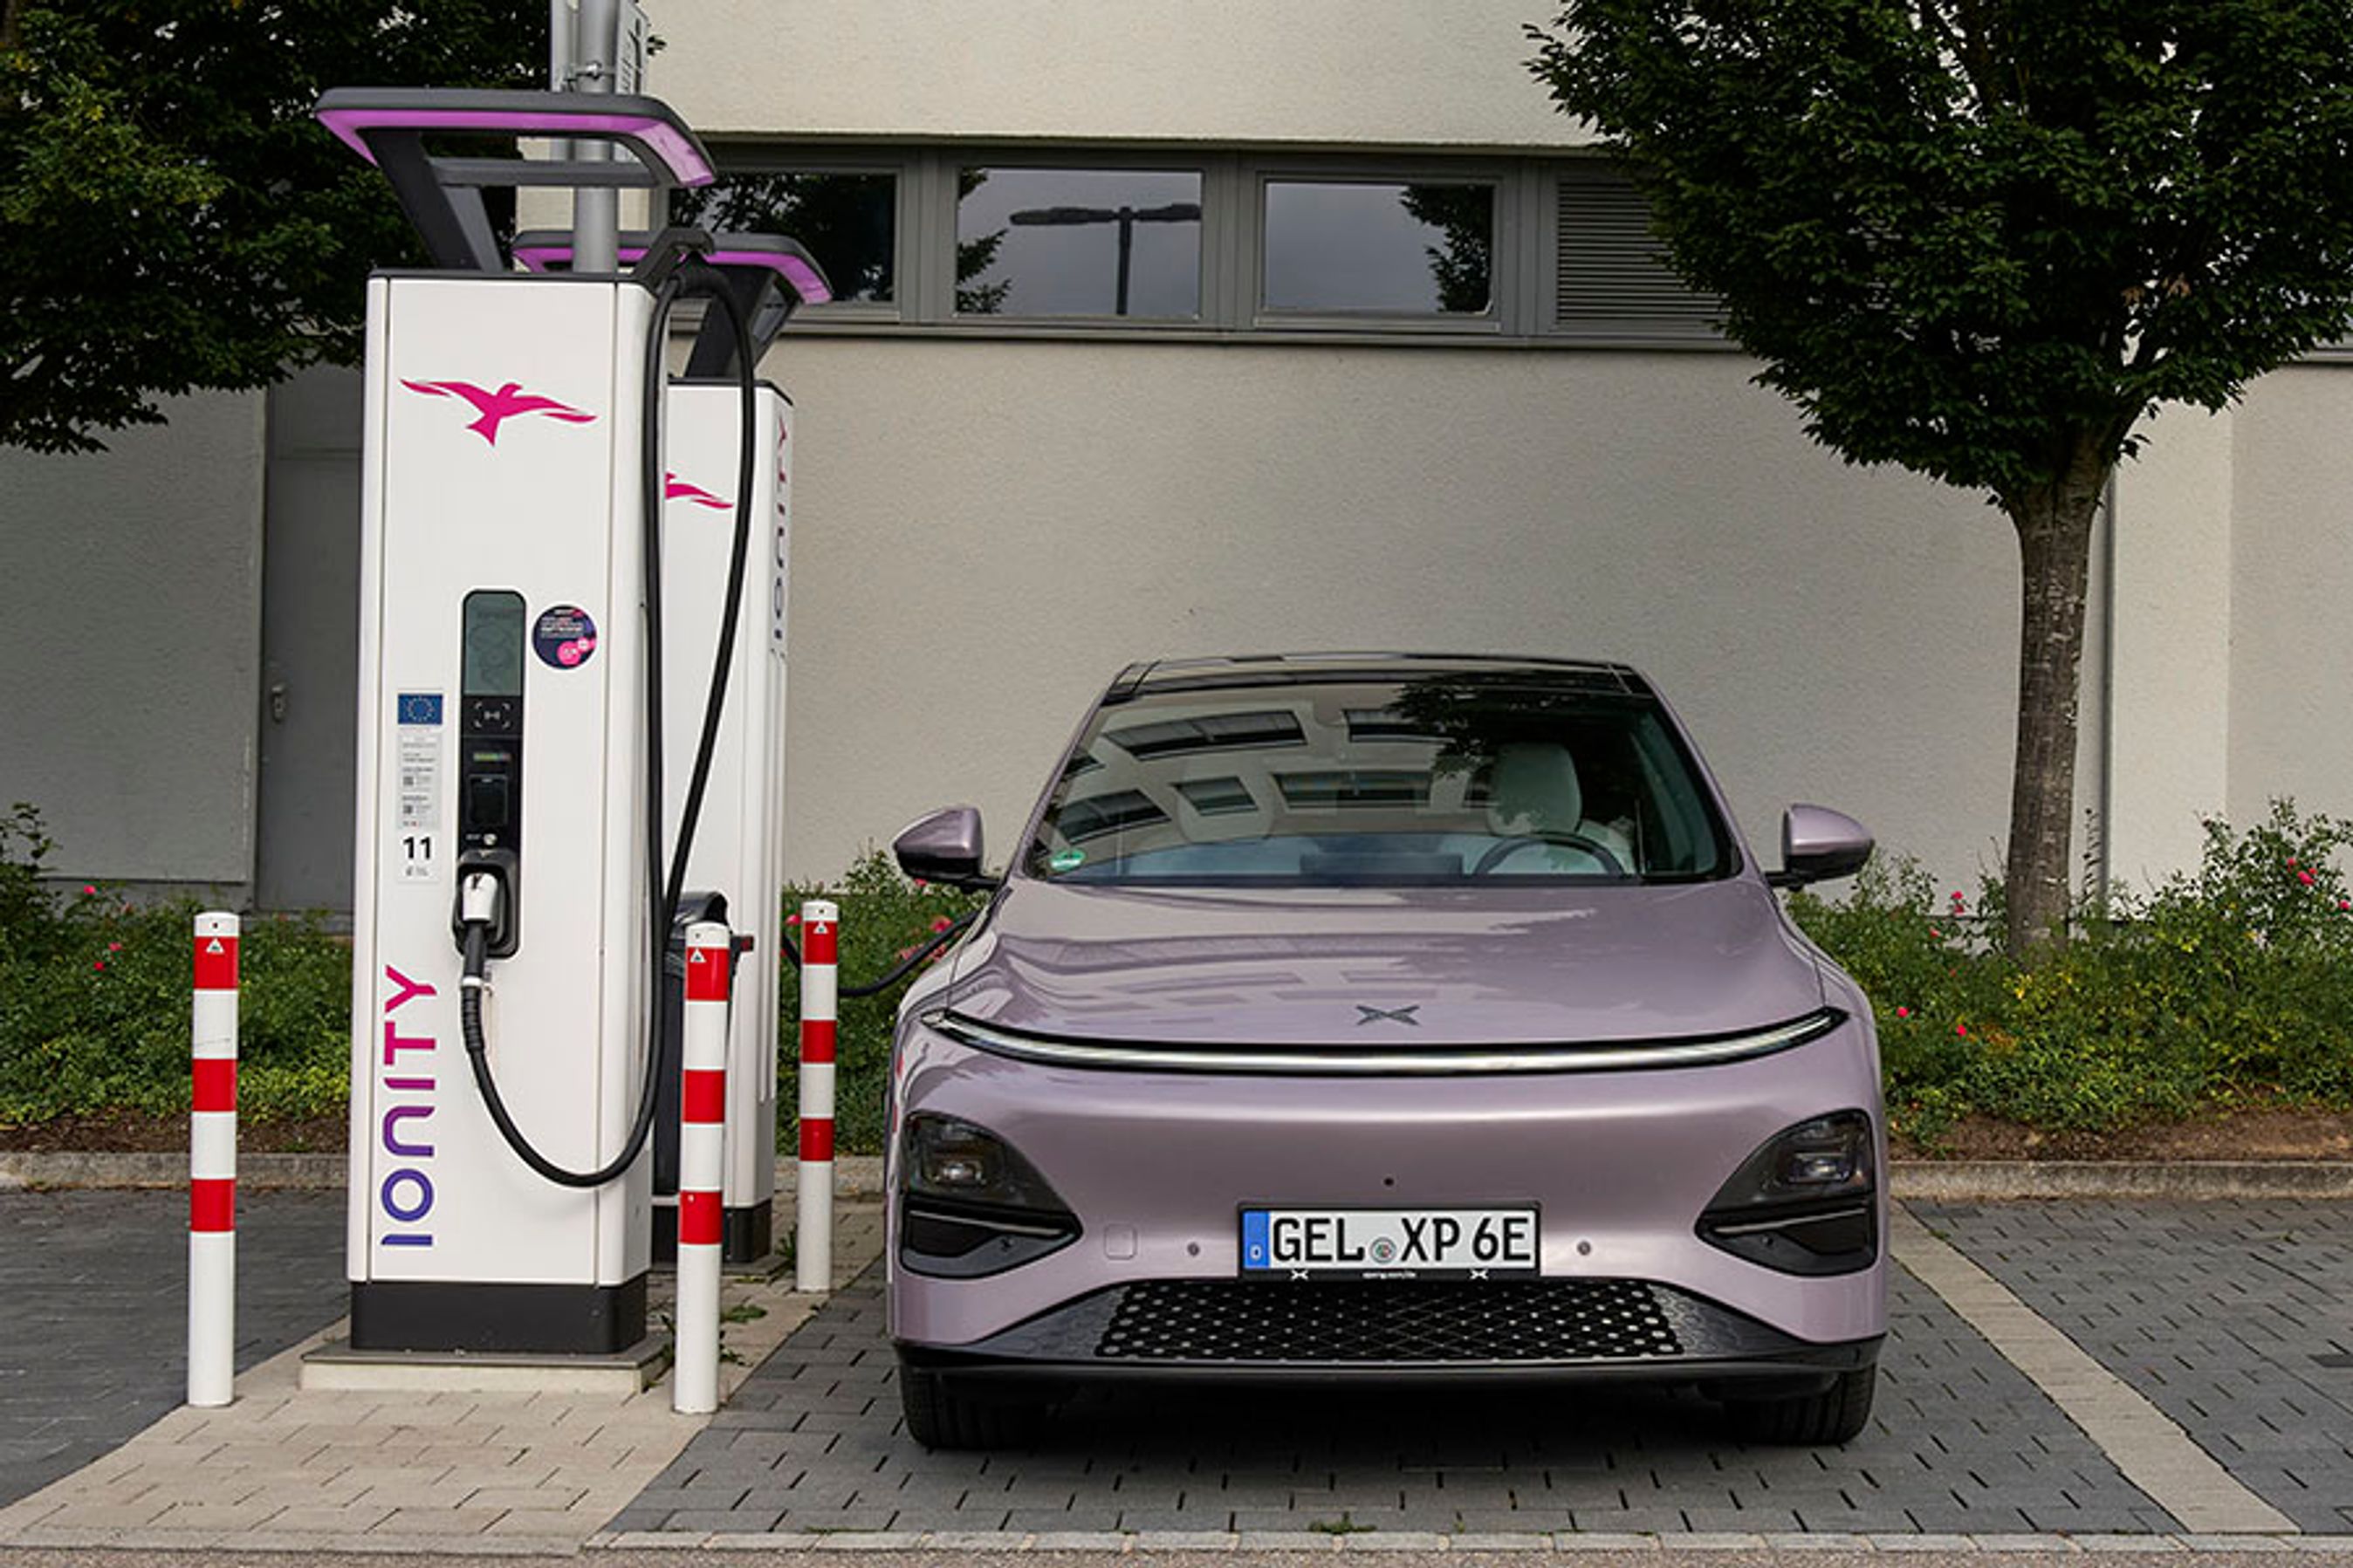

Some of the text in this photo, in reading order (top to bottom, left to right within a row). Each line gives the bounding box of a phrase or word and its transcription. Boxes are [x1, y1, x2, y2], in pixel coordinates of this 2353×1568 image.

[403, 836, 432, 859] 11
[381, 965, 437, 1245] IONITY
[1273, 1218, 1531, 1262] GEL XP 6E
